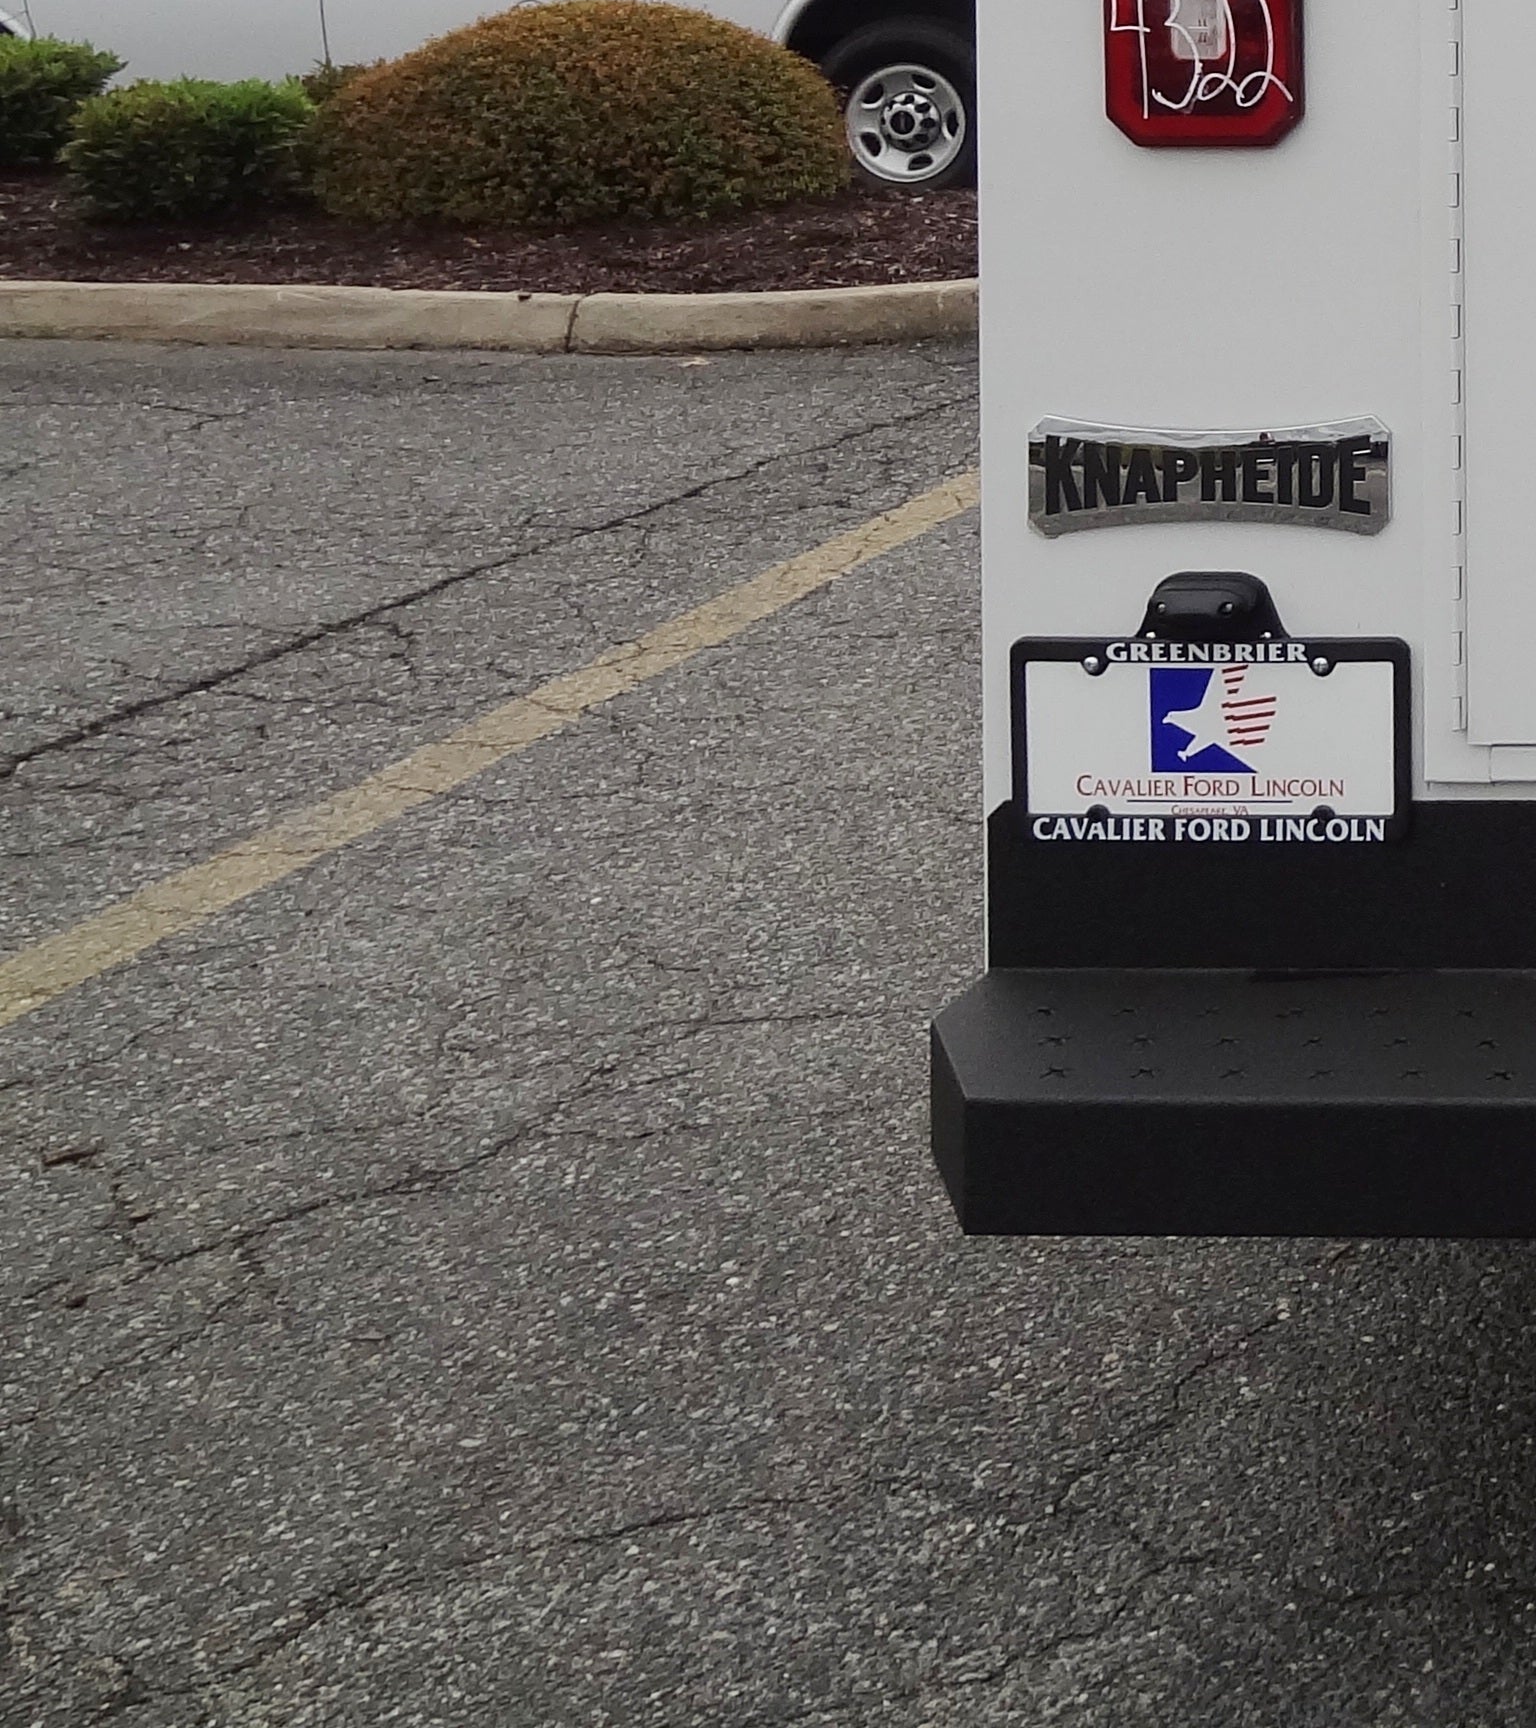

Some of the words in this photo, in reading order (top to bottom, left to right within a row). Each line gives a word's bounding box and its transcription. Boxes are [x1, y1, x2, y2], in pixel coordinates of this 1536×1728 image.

[1045, 434, 1371, 515] KNAPHEIDE
[1105, 643, 1309, 662] GREENBRIER
[1033, 818, 1166, 841] CAVALIER
[1175, 818, 1251, 841] FORD
[1260, 818, 1386, 842] LINCOLN
